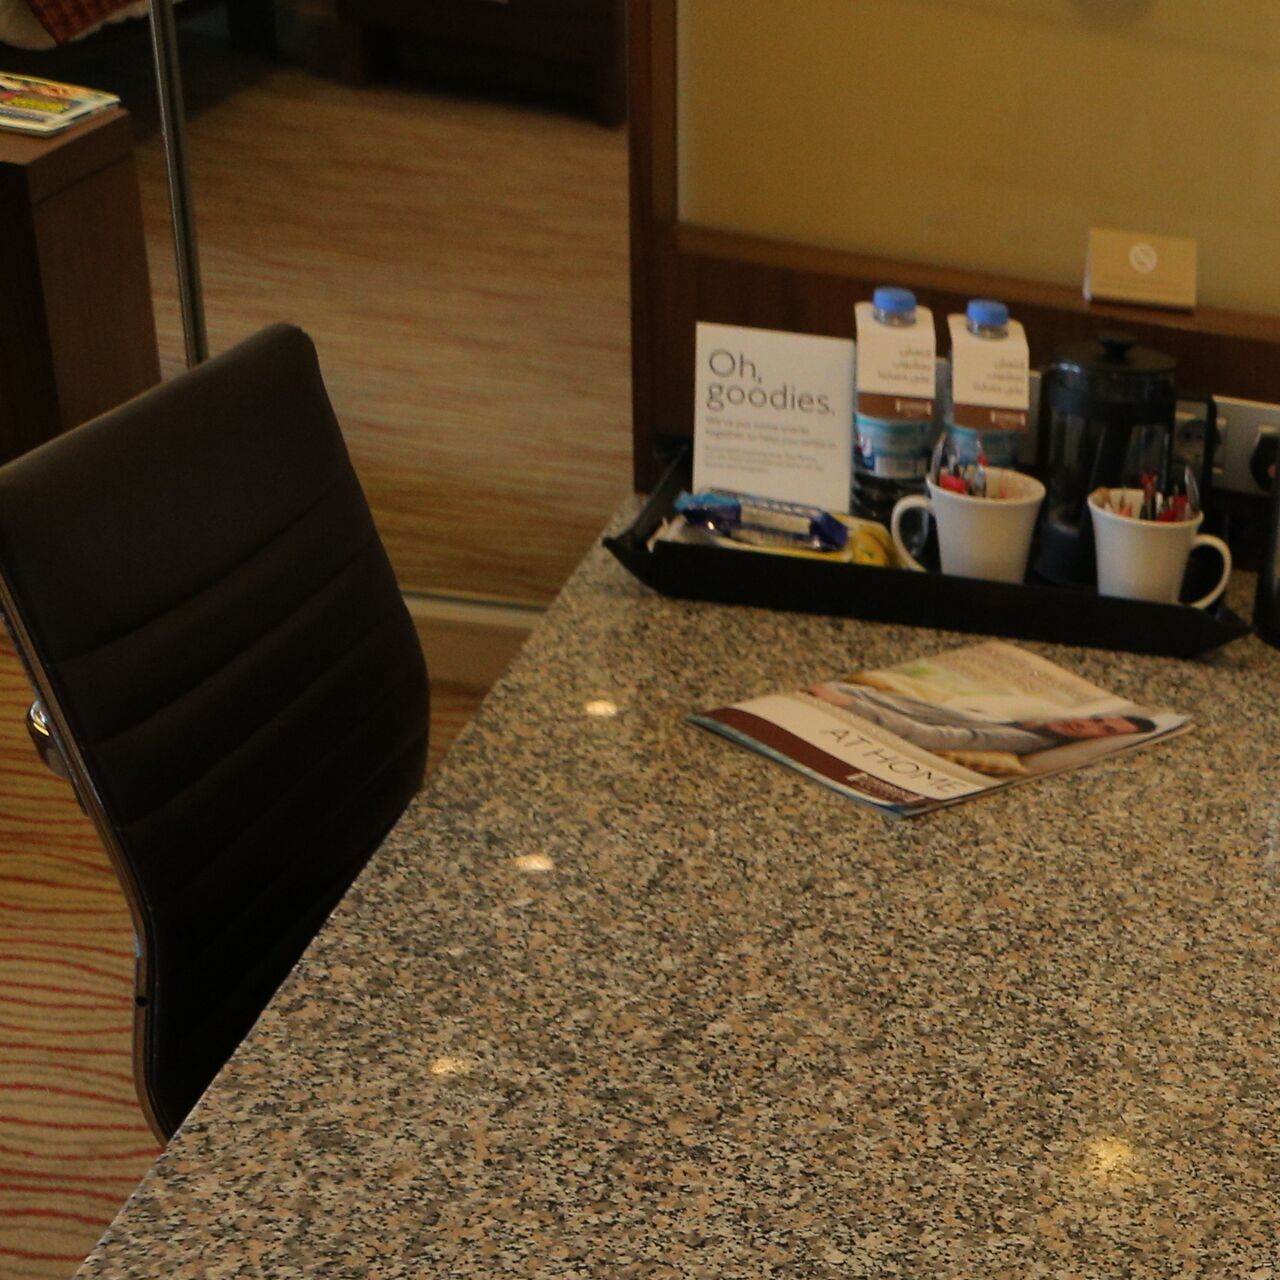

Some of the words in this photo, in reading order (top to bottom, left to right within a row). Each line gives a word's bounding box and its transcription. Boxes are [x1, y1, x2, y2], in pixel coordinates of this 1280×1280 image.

[709, 348, 762, 384] Oh,
[706, 383, 836, 416] goodies.
[819, 730, 873, 747] AT
[862, 747, 967, 792] HOME
